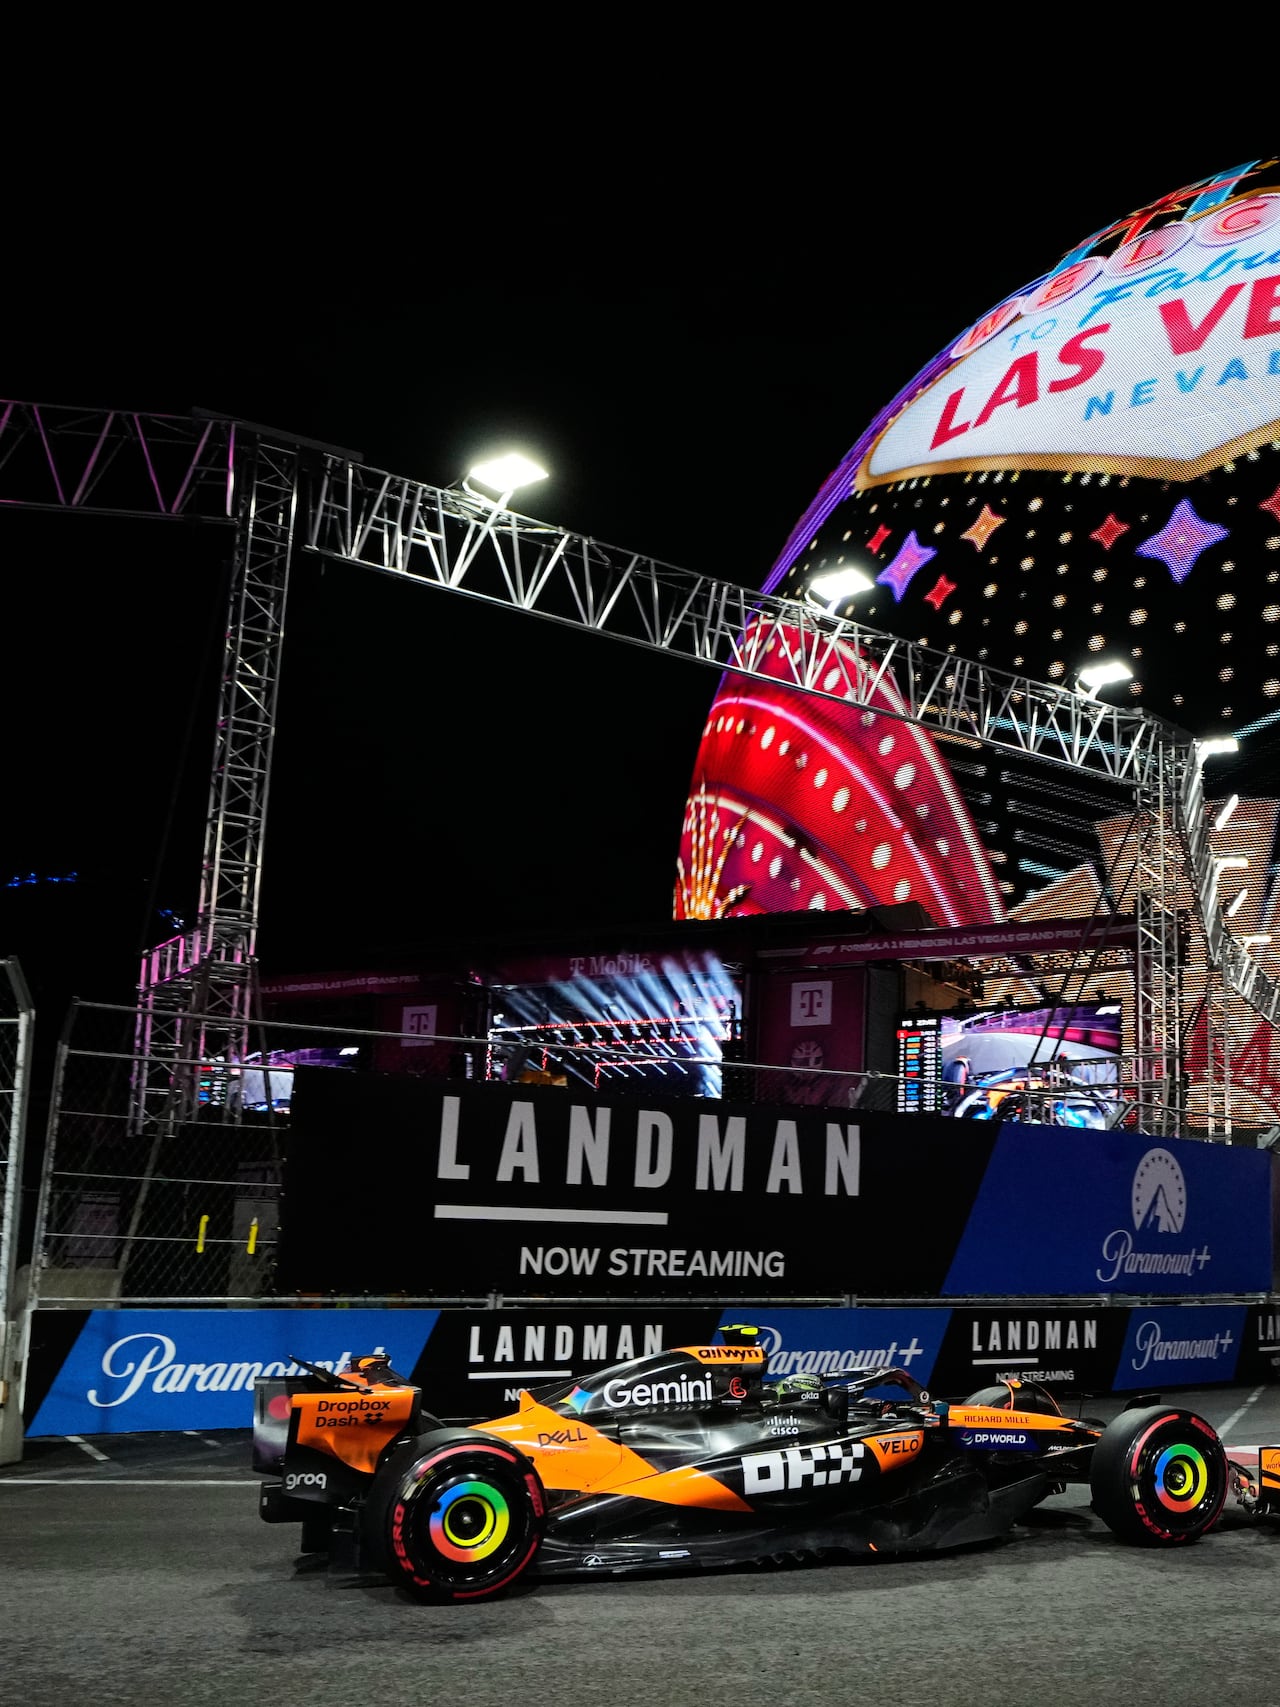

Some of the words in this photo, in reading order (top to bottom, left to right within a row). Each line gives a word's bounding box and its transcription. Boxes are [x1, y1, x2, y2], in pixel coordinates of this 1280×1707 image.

[1008, 318, 1058, 351] TO
[929, 323, 1111, 451] LAS
[954, 936, 976, 946] LAS
[977, 934, 1015, 944] VEGAS
[1016, 931, 1055, 941] GRAND
[1056, 929, 1082, 939] PRIX
[589, 953, 651, 976] Mobile
[436, 1095, 861, 1196] LANDMAN
[519, 1246, 601, 1276] NOW
[607, 1248, 786, 1278] STREAMING
[1096, 1229, 1211, 1284] Paramount+
[468, 1324, 664, 1363] LANDMAN
[758, 1326, 924, 1376] Paramount+
[972, 1319, 1098, 1351] LANDMAN
[1132, 1320, 1234, 1371] Paramount+
[87, 1333, 391, 1408] Paramount
[995, 1371, 1020, 1383] NOW
[1022, 1370, 1075, 1383] STREAMING
[603, 1371, 713, 1408] Gemini
[800, 1391, 820, 1400] okta
[315, 1414, 359, 1428] Dash
[317, 1399, 391, 1414] Dropbox
[964, 1415, 1002, 1424] RICHARD
[1004, 1416, 1031, 1424] MILLE
[537, 1427, 588, 1447] DELL
[878, 1439, 920, 1455] VELO
[974, 1433, 989, 1444] DP
[989, 1434, 1027, 1445] WORLD
[285, 1472, 328, 1490] groq
[741, 1443, 866, 1496] OKX
